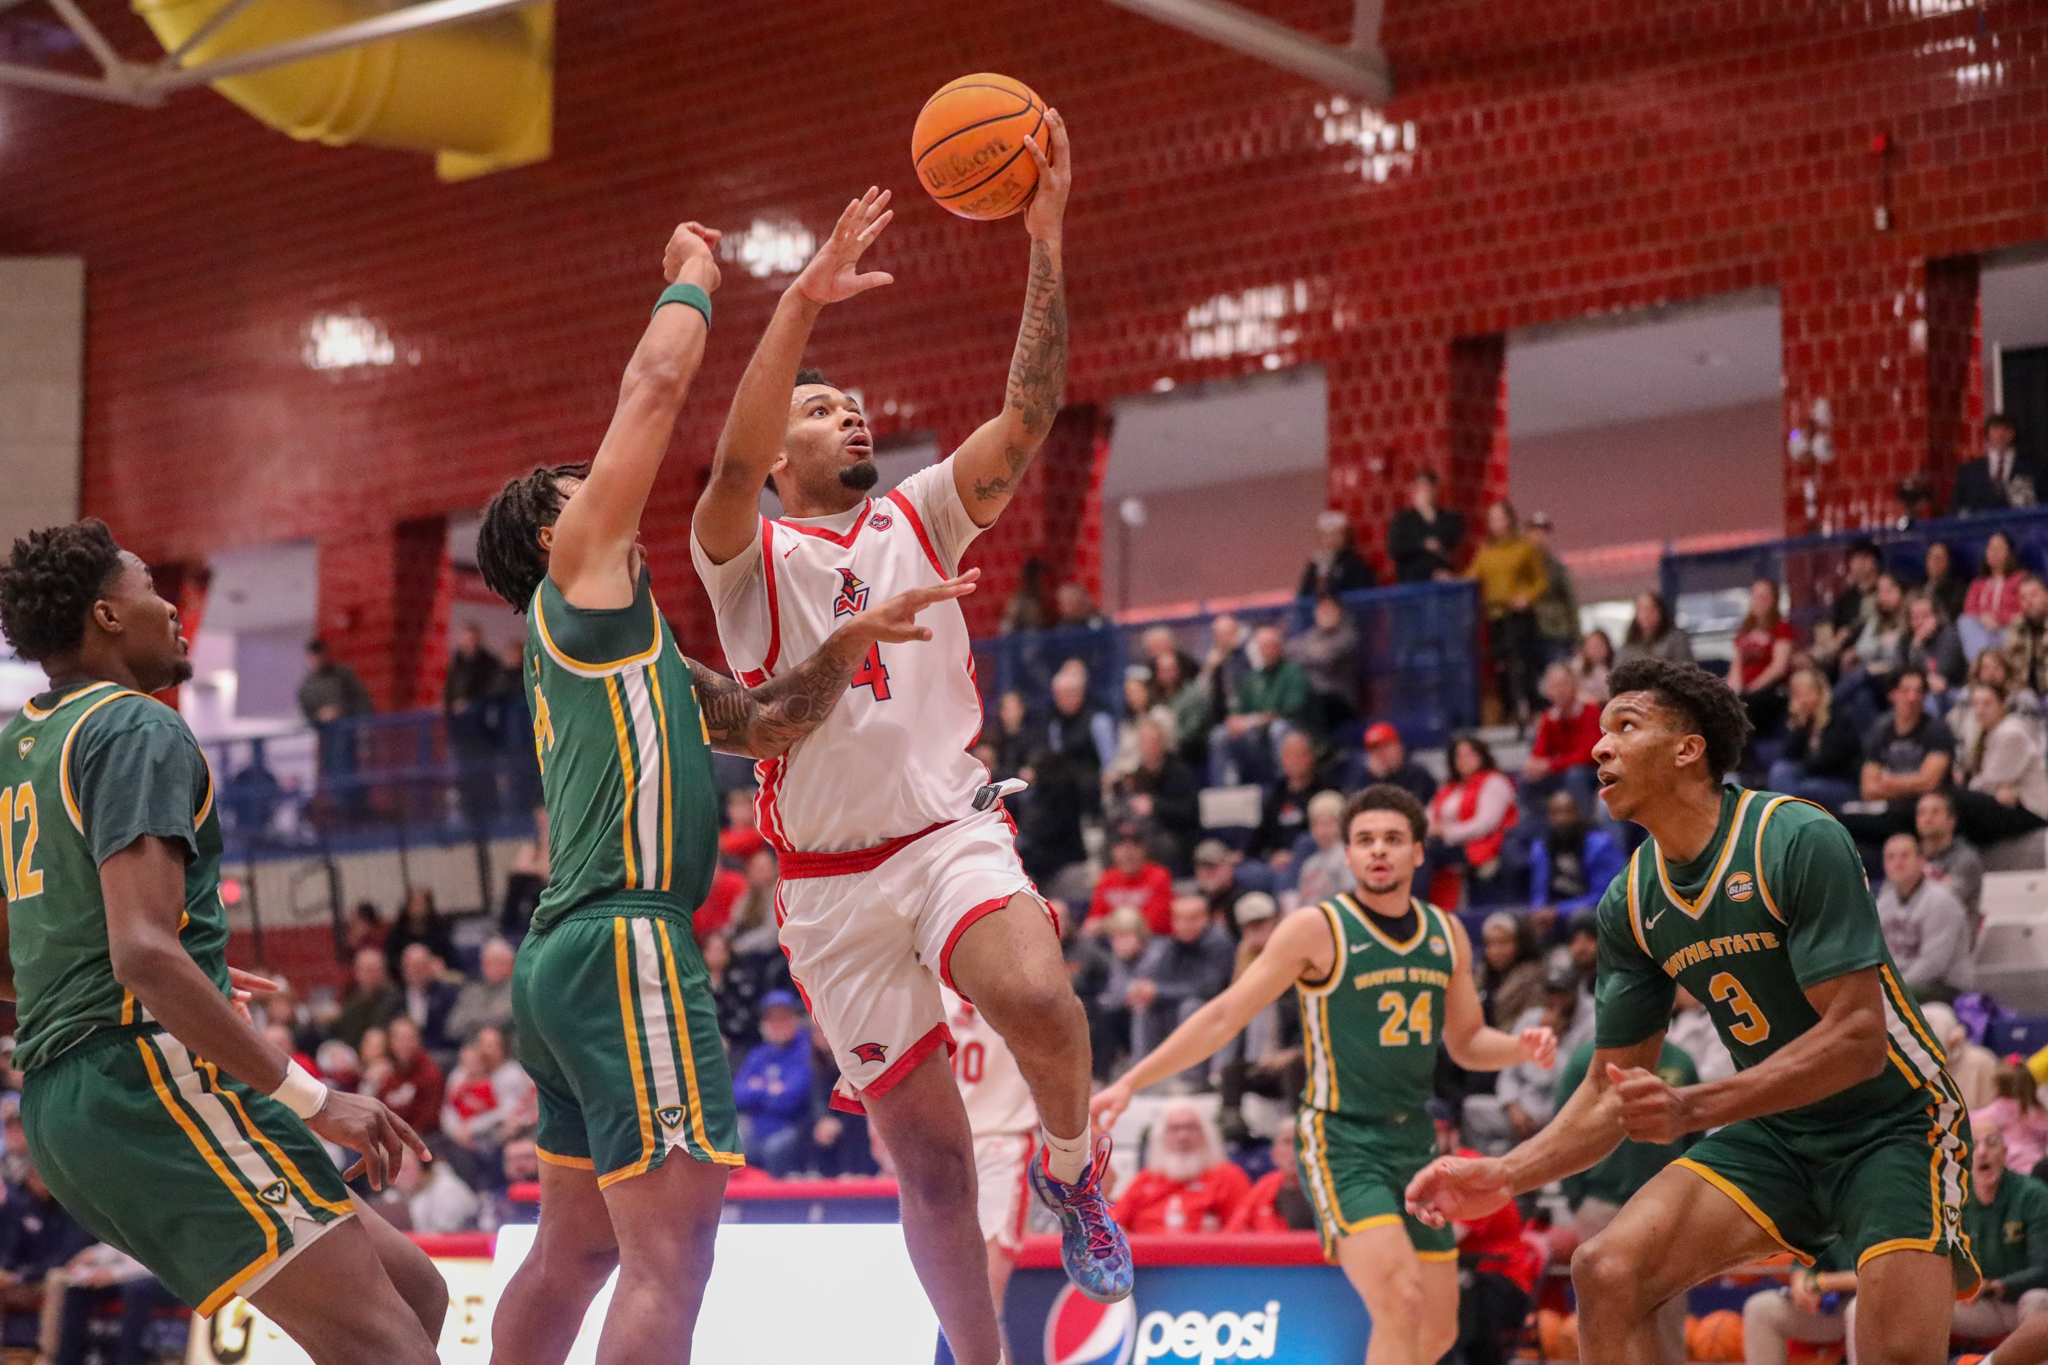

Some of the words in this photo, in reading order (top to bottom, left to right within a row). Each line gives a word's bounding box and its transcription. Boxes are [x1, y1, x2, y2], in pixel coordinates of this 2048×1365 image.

[923, 138, 1008, 190] Wilson
[851, 640, 891, 702] 4
[0, 781, 44, 903] 12
[1728, 882, 1754, 895] GLIAC
[1710, 931, 1780, 957] STATE
[1378, 990, 1432, 1047] 24
[1708, 971, 1771, 1046] 3
[1133, 1299, 1282, 1365] pepsi
